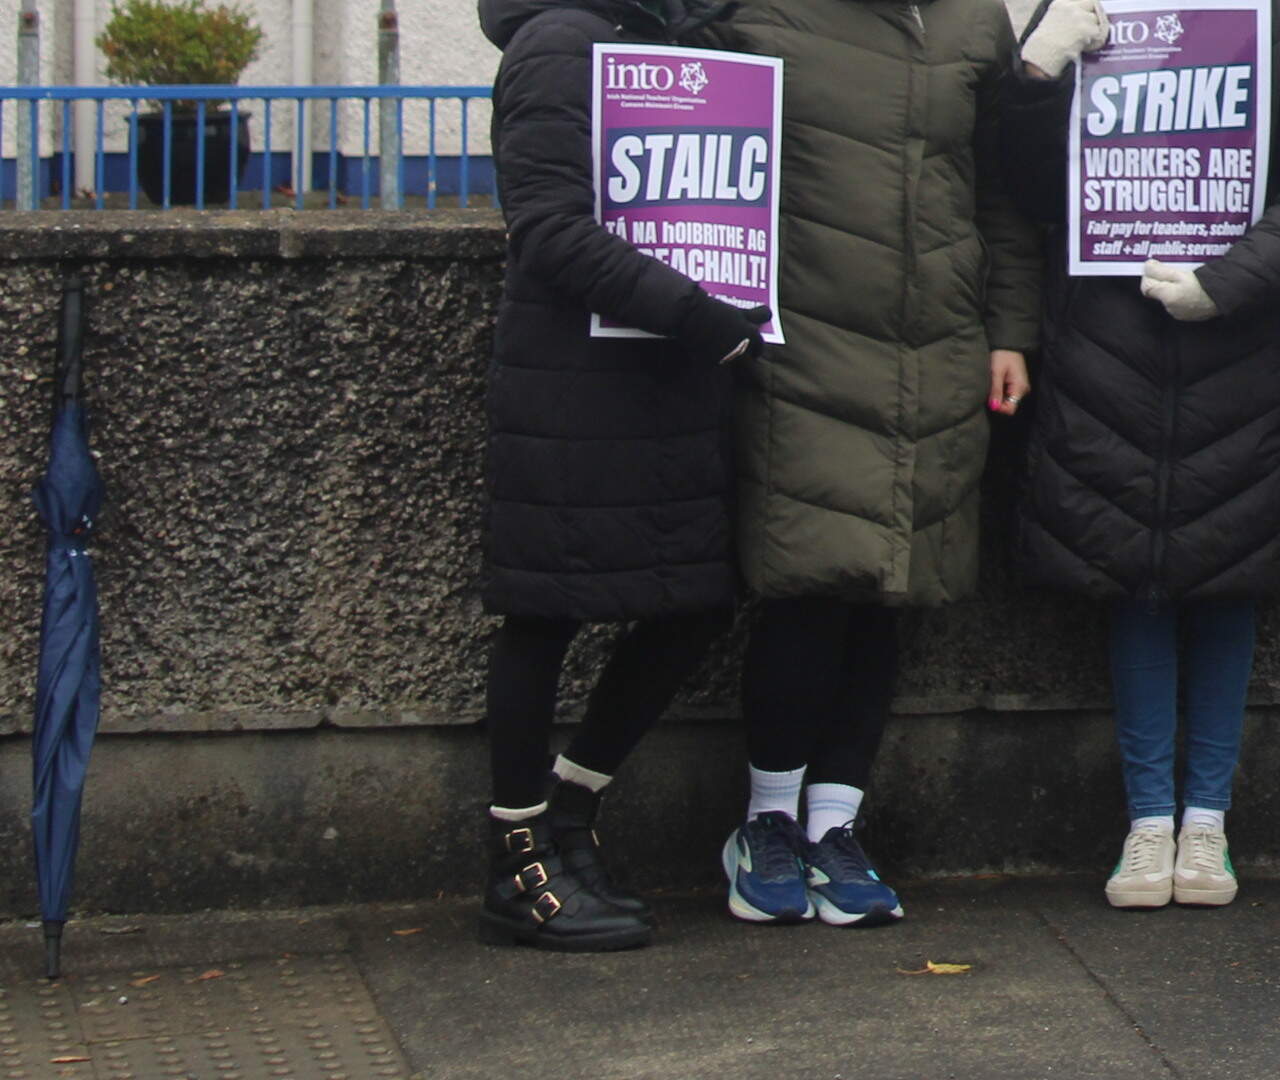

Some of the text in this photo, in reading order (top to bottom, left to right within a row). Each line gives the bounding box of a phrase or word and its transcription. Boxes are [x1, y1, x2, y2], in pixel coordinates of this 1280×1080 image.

[1109, 18, 1150, 46] nto
[606, 57, 674, 92] into
[1086, 65, 1251, 137] STRIKE
[607, 133, 769, 204] STAILC
[1084, 147, 1252, 178] WORKERS ARE
[1084, 179, 1250, 214] STRUGGLING!
[632, 221, 657, 244] NA
[662, 221, 745, 249] hOIBRITHE
[747, 228, 767, 252] AG
[1086, 220, 1110, 235] Fair
[1109, 223, 1134, 238] pay
[1133, 220, 1153, 235] for
[1152, 221, 1209, 237] teachers,
[1092, 240, 1122, 255] staff
[1123, 244, 1133, 255] +
[1132, 240, 1150, 255] all
[1148, 240, 1186, 258] public
